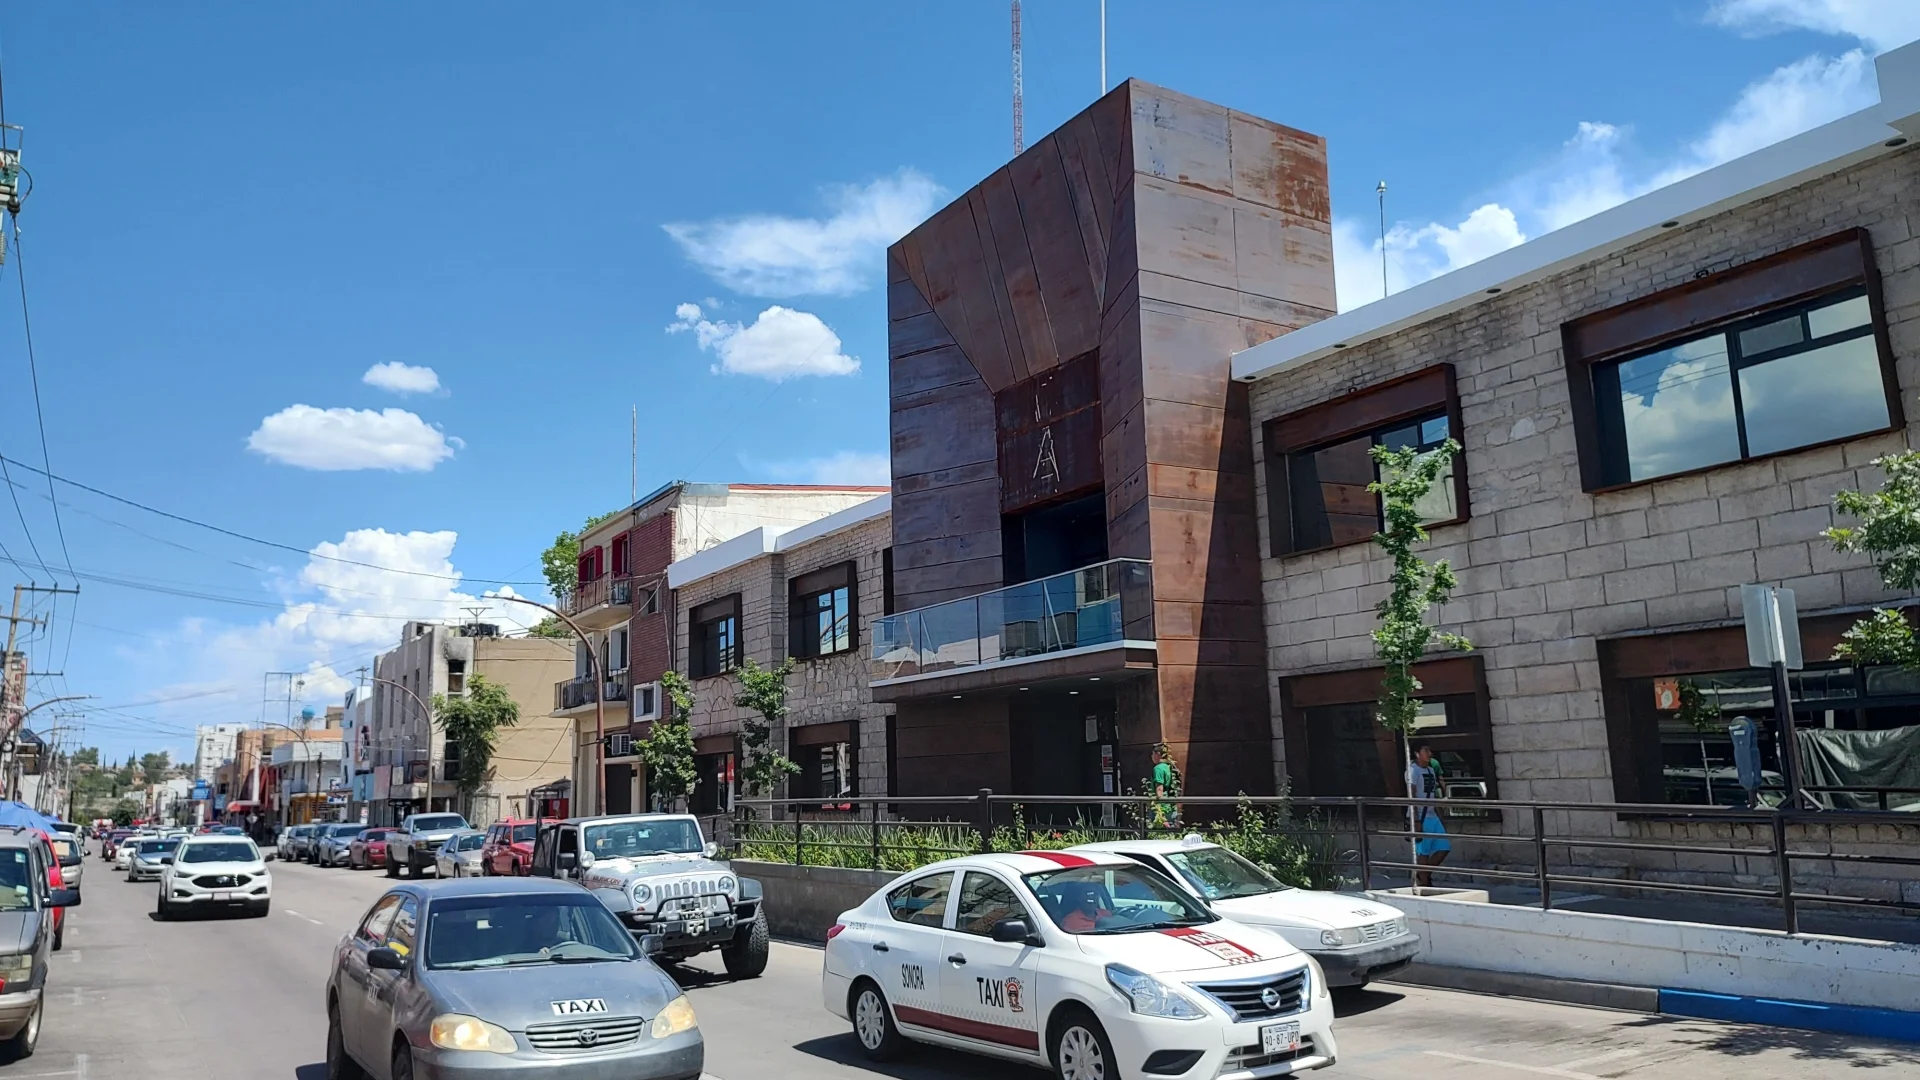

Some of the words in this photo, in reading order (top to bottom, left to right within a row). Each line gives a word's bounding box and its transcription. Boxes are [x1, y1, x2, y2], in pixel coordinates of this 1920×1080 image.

[1350, 908, 1378, 918] TAXI
[902, 963, 925, 990] SONORA
[976, 977, 1004, 1008] TAXI
[552, 999, 606, 1014] TAXI
